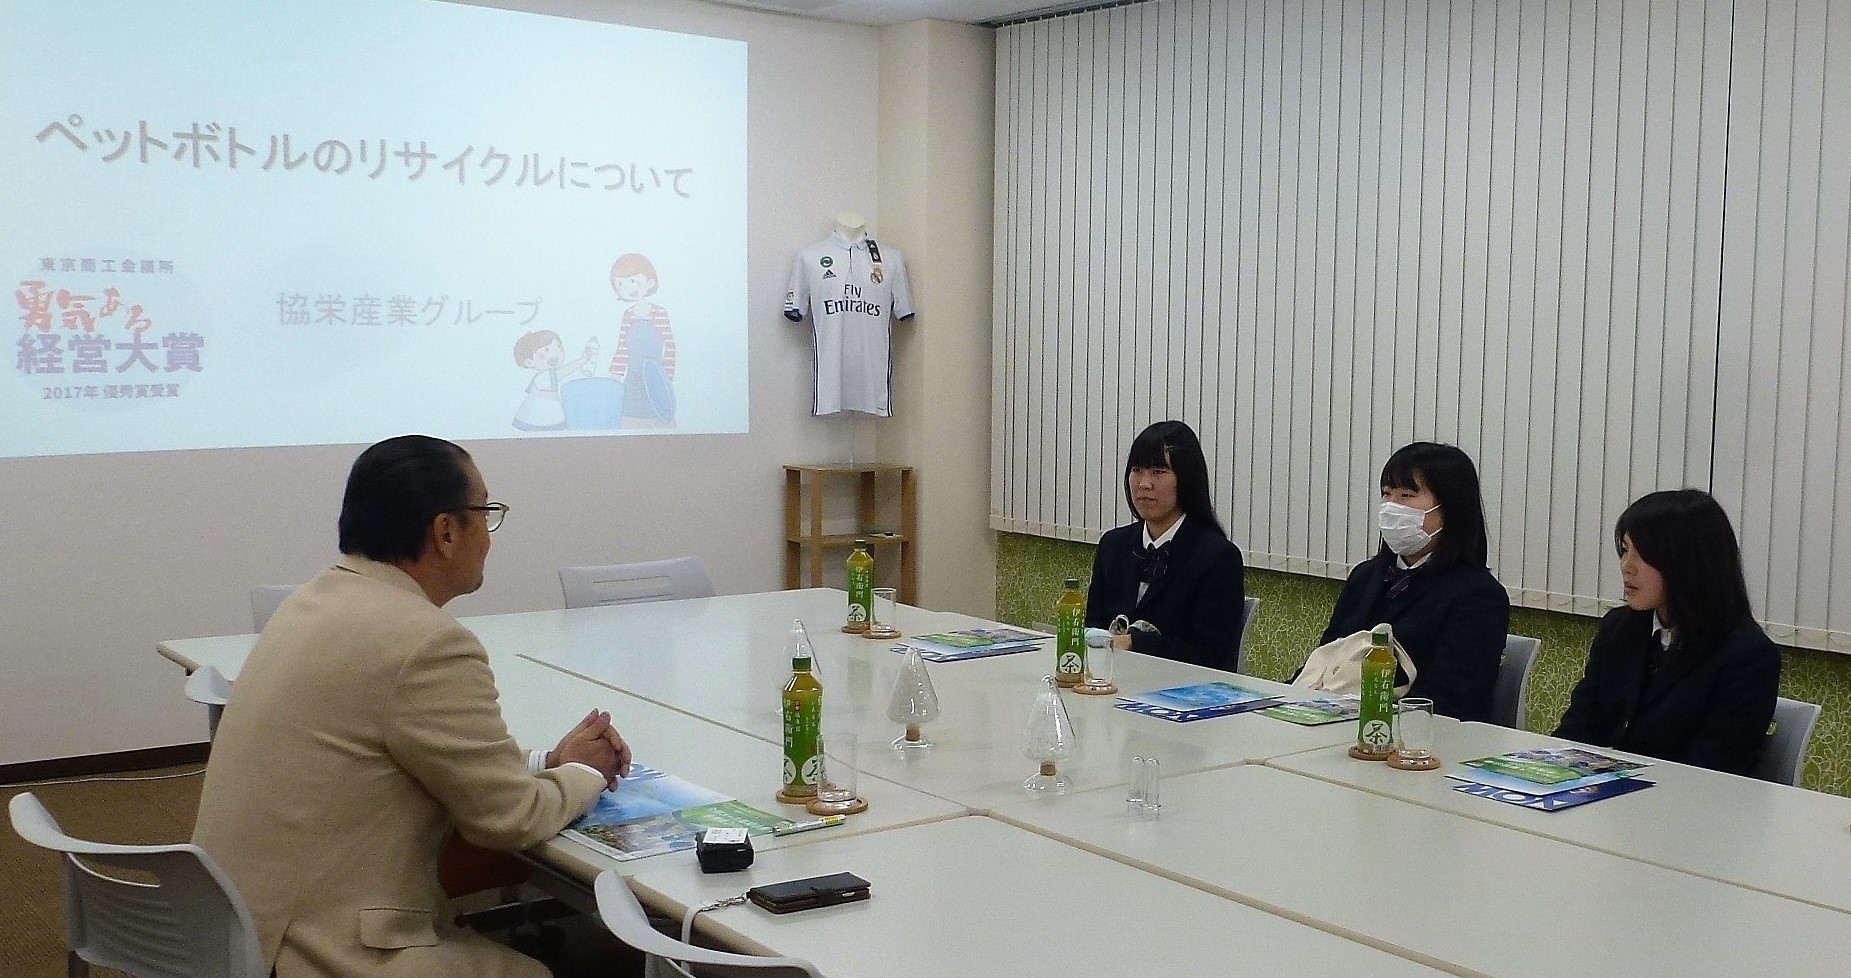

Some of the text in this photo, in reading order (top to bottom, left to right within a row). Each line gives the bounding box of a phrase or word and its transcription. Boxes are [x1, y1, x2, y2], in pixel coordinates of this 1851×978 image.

[35, 113, 694, 198] ペットボトルのリサイクルについて
[844, 283, 861, 298] Fly
[15, 280, 152, 333] 勇気ある
[276, 293, 544, 326] 協栄産業グループ
[16, 332, 205, 374] 経営大賞
[848, 605, 863, 622] 茶
[1061, 655, 1080, 674] 茶
[1365, 723, 1388, 744] 茶
